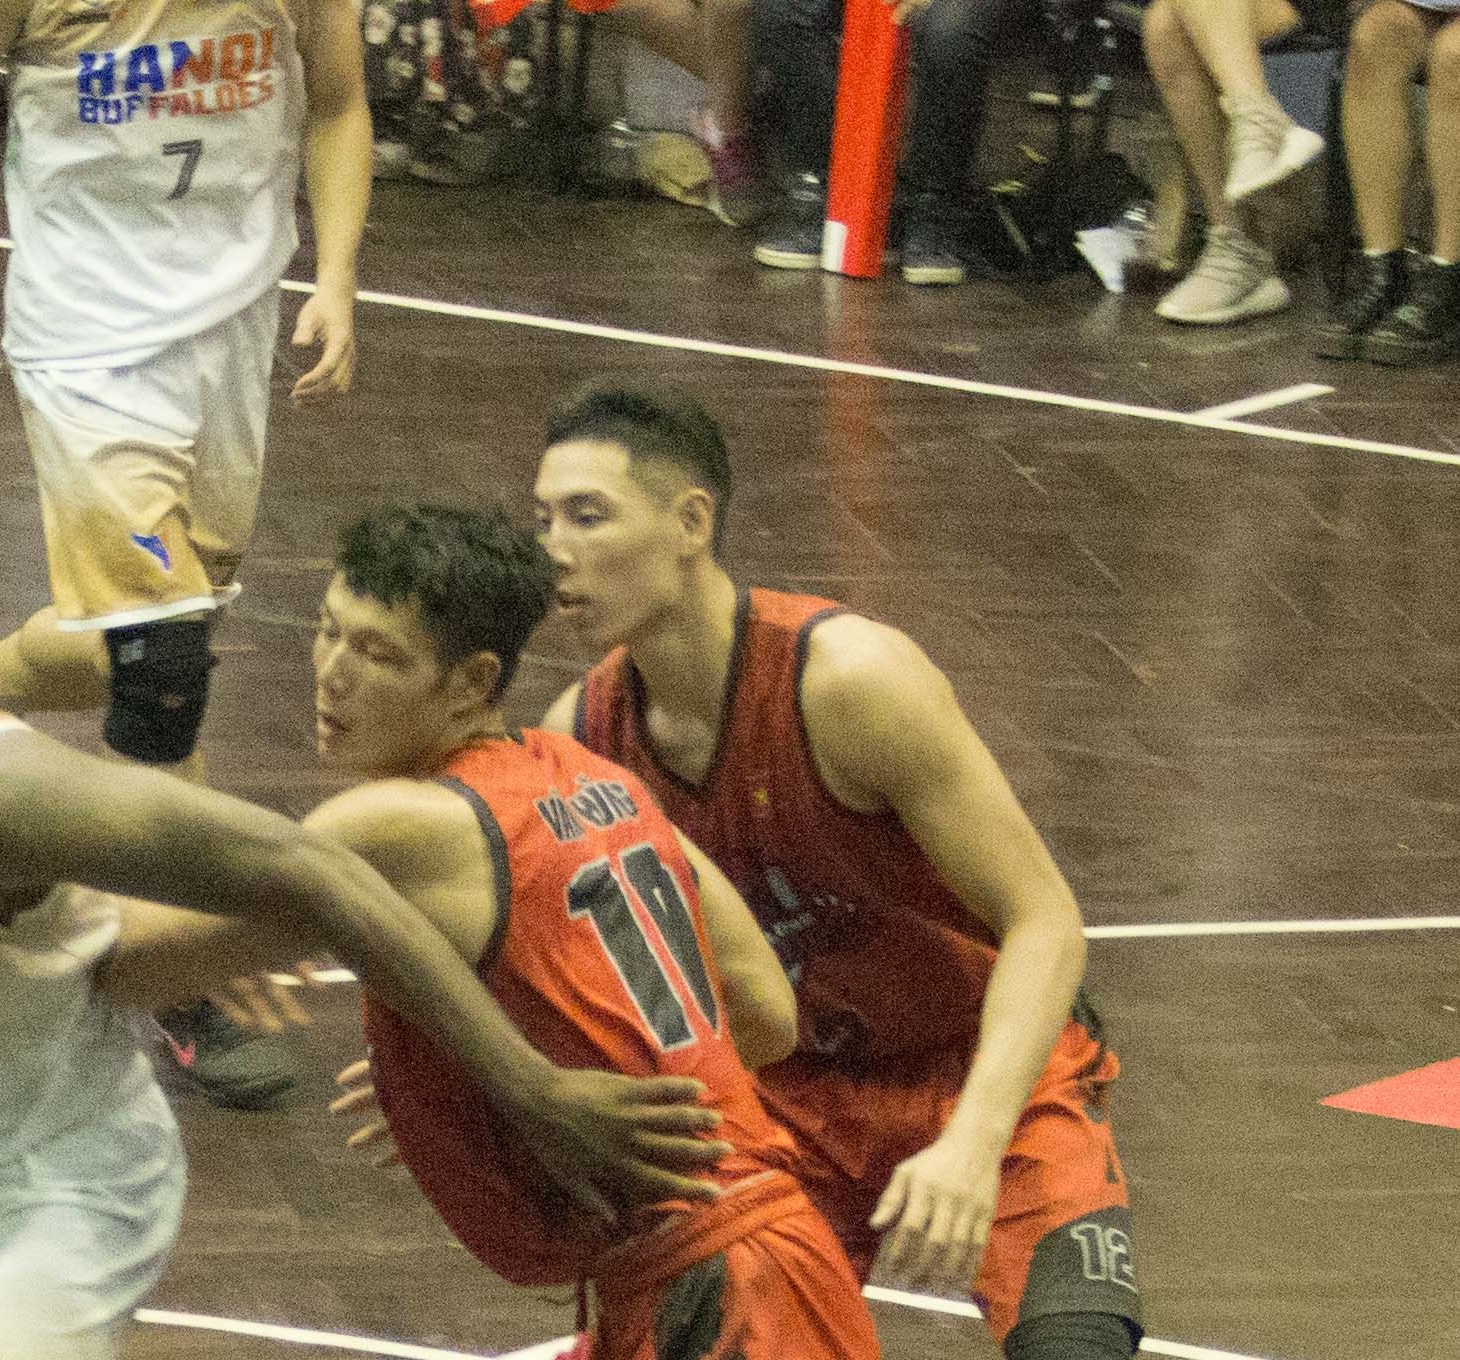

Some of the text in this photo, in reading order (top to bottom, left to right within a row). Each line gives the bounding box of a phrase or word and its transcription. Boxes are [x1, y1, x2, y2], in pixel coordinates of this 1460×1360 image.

[78, 28, 273, 97] HANOI
[162, 139, 203, 200] 7
[1070, 1222, 1138, 1294] 12
